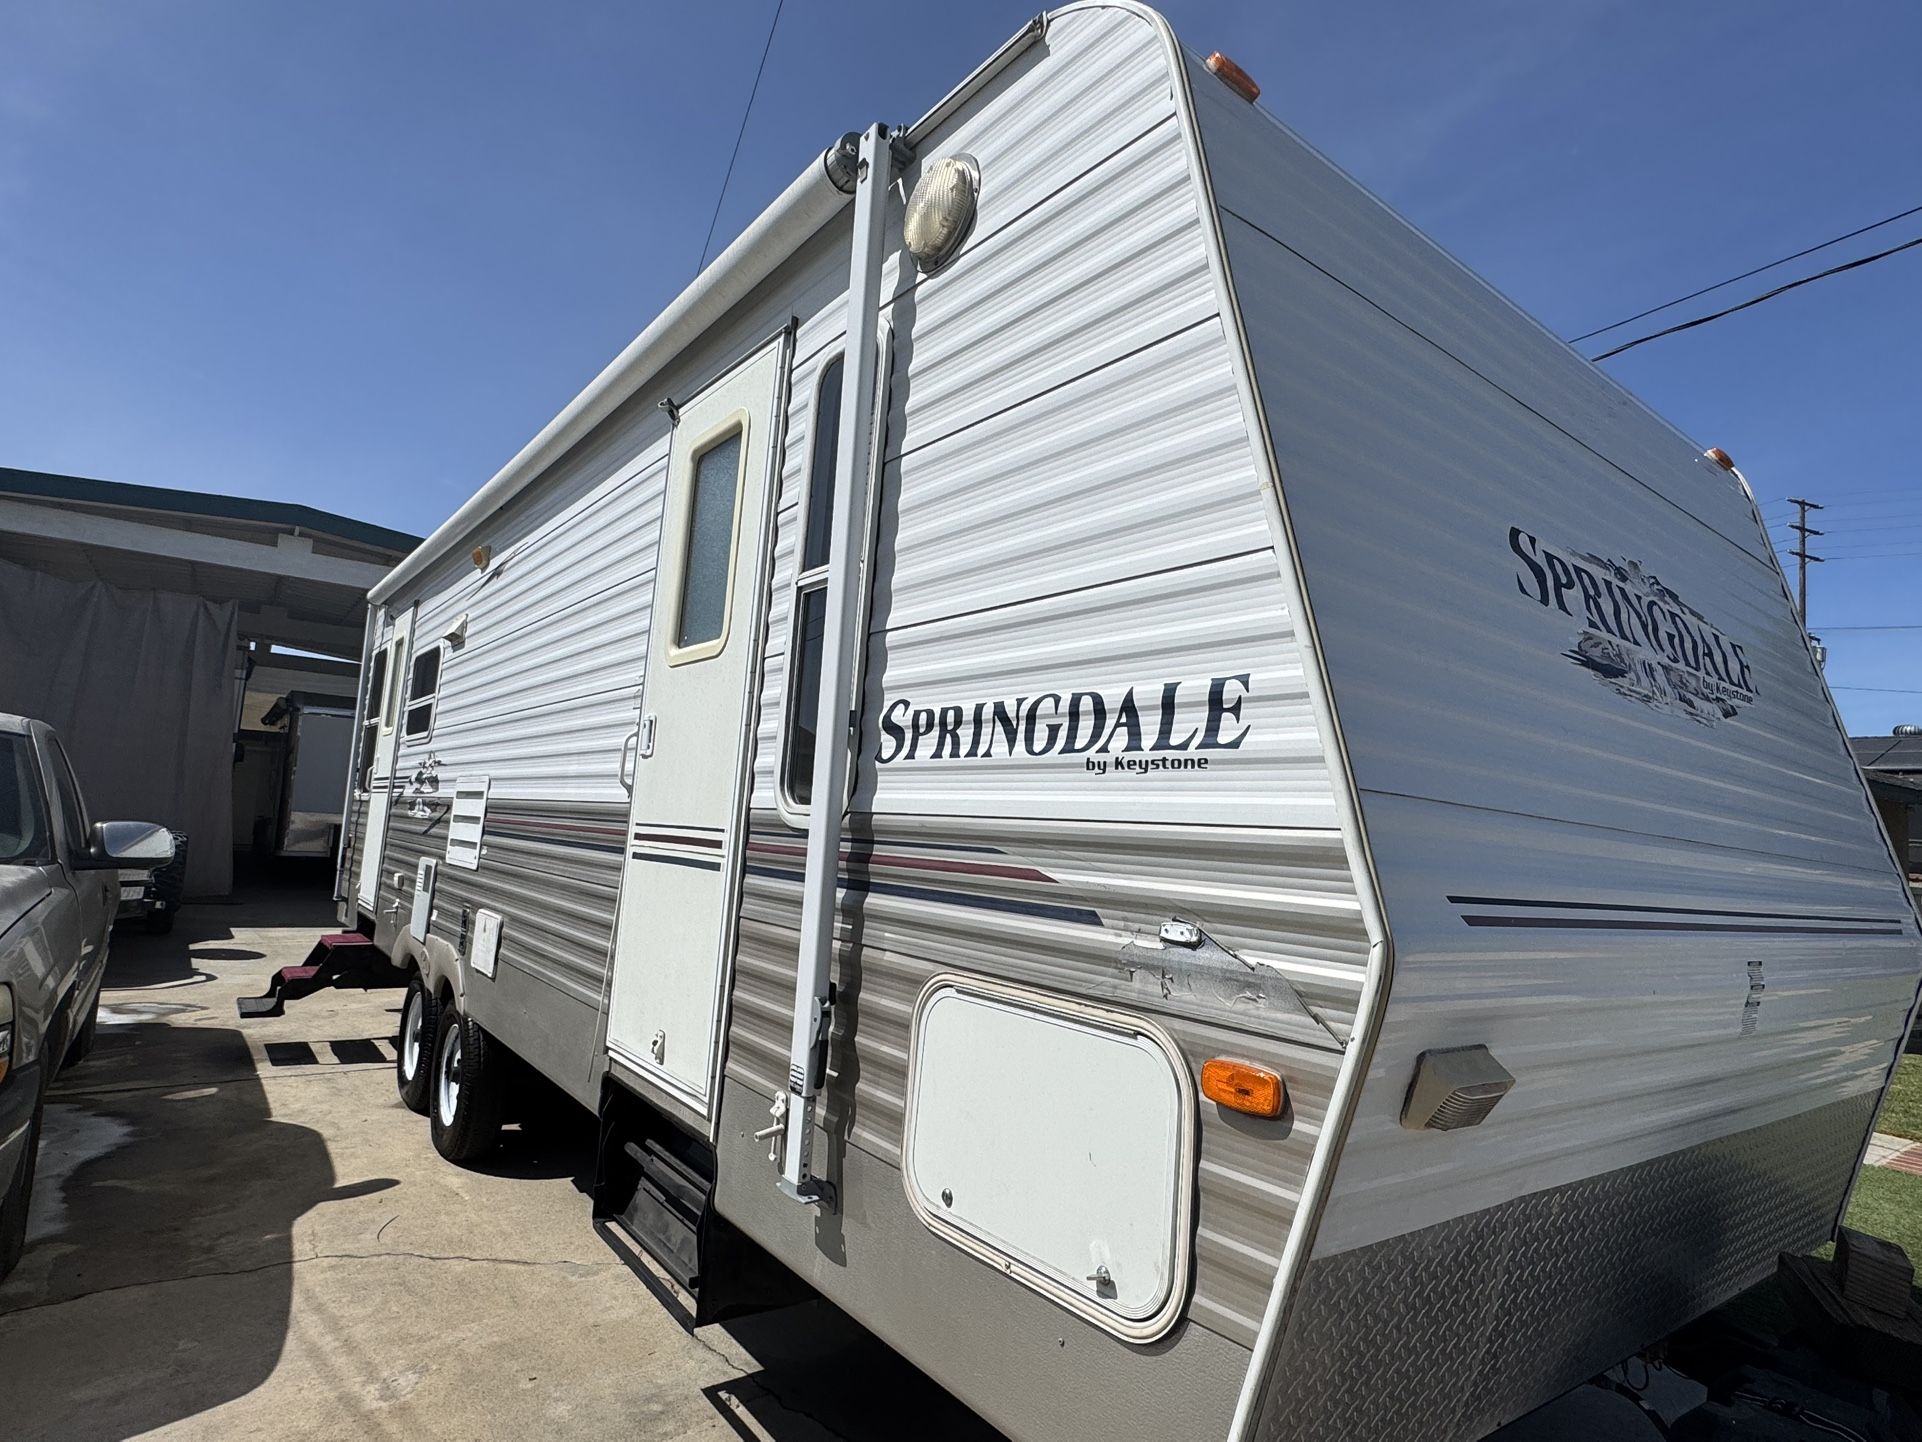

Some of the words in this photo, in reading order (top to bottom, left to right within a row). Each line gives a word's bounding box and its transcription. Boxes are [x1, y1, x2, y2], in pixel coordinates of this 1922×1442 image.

[1508, 526, 1760, 696] SPRINGDALE
[875, 673, 1251, 764] SPRINGDALE
[1702, 676, 1714, 695] by
[1715, 681, 1754, 705] Keystone
[1086, 757, 1107, 775] by
[1114, 755, 1209, 775] Keystone
